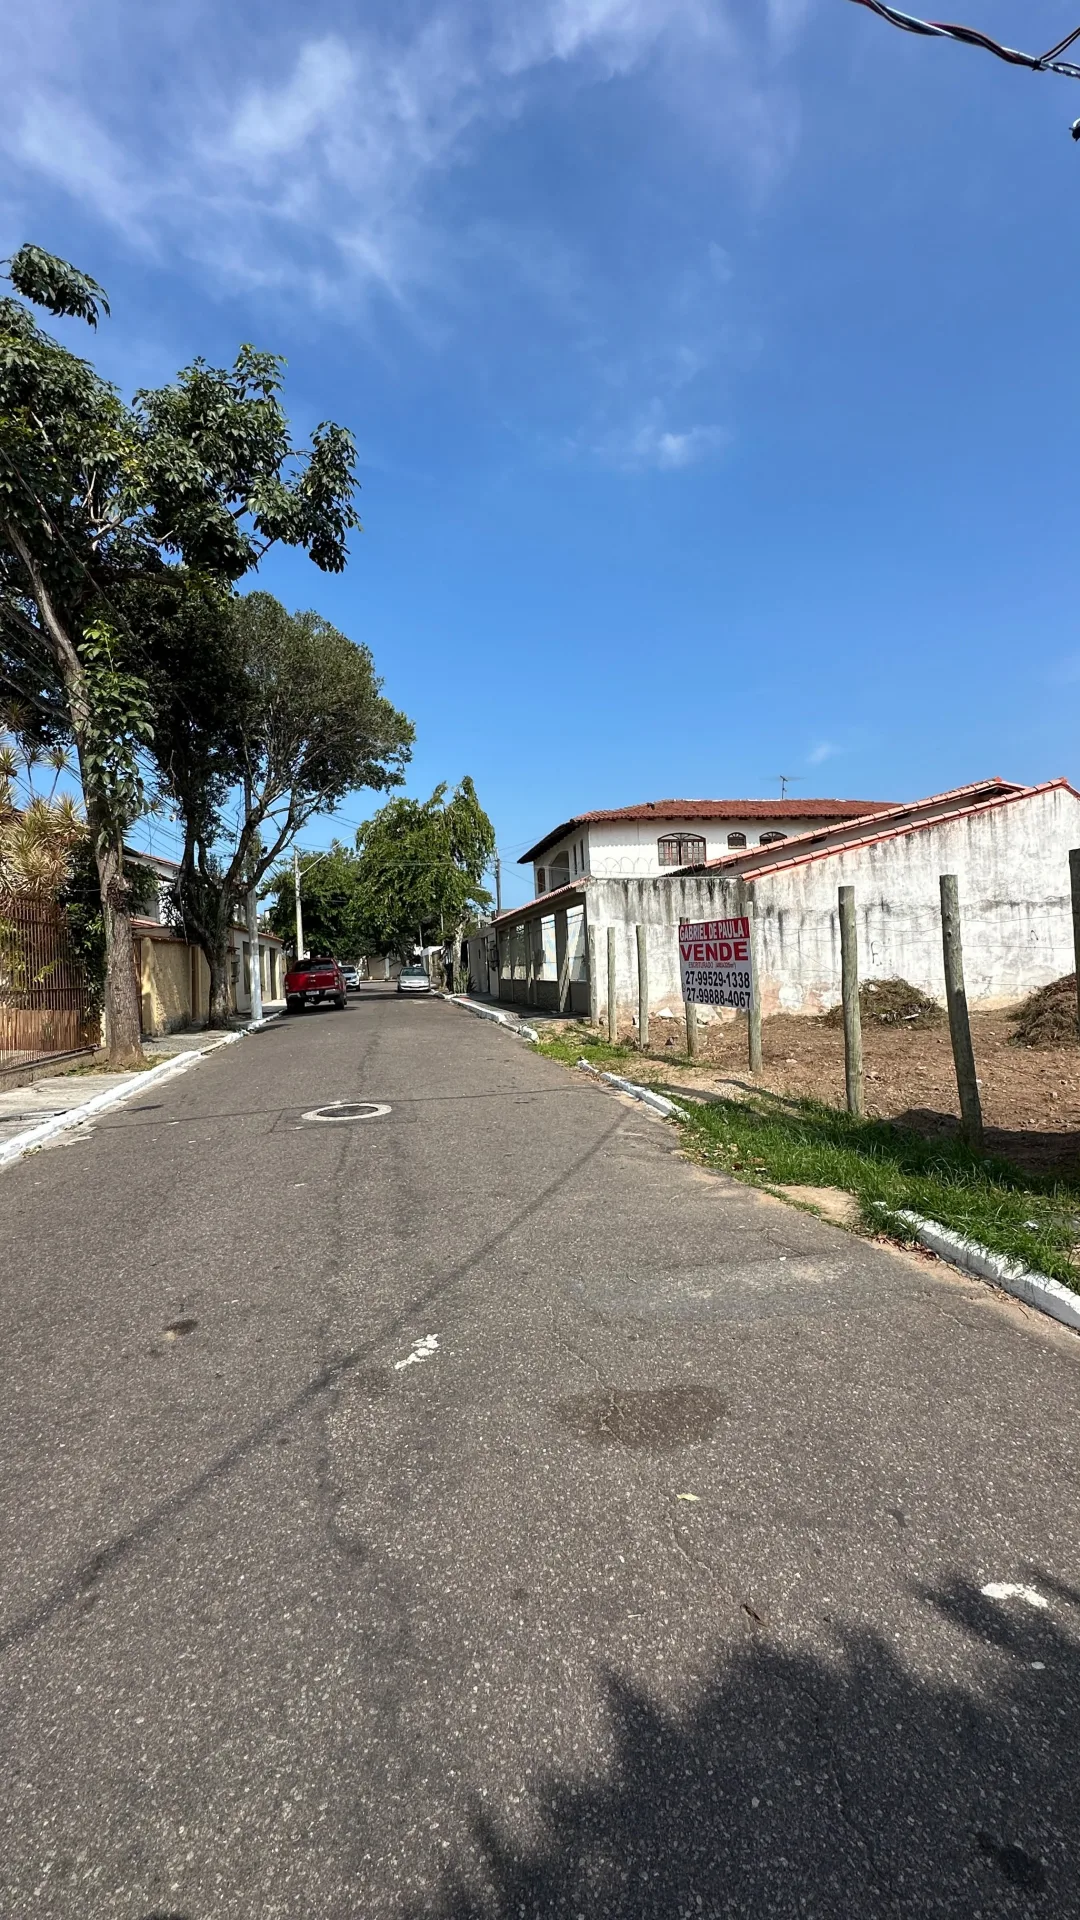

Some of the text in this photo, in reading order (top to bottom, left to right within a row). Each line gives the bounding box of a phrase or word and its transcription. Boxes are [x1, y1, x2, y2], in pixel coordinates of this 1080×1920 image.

[680, 920, 745, 942] GABRIEL DE PAULA
[680, 941, 749, 961] VENDE
[685, 971, 750, 988] 27-99529-1338
[686, 988, 751, 1008] 27-99888-4067
